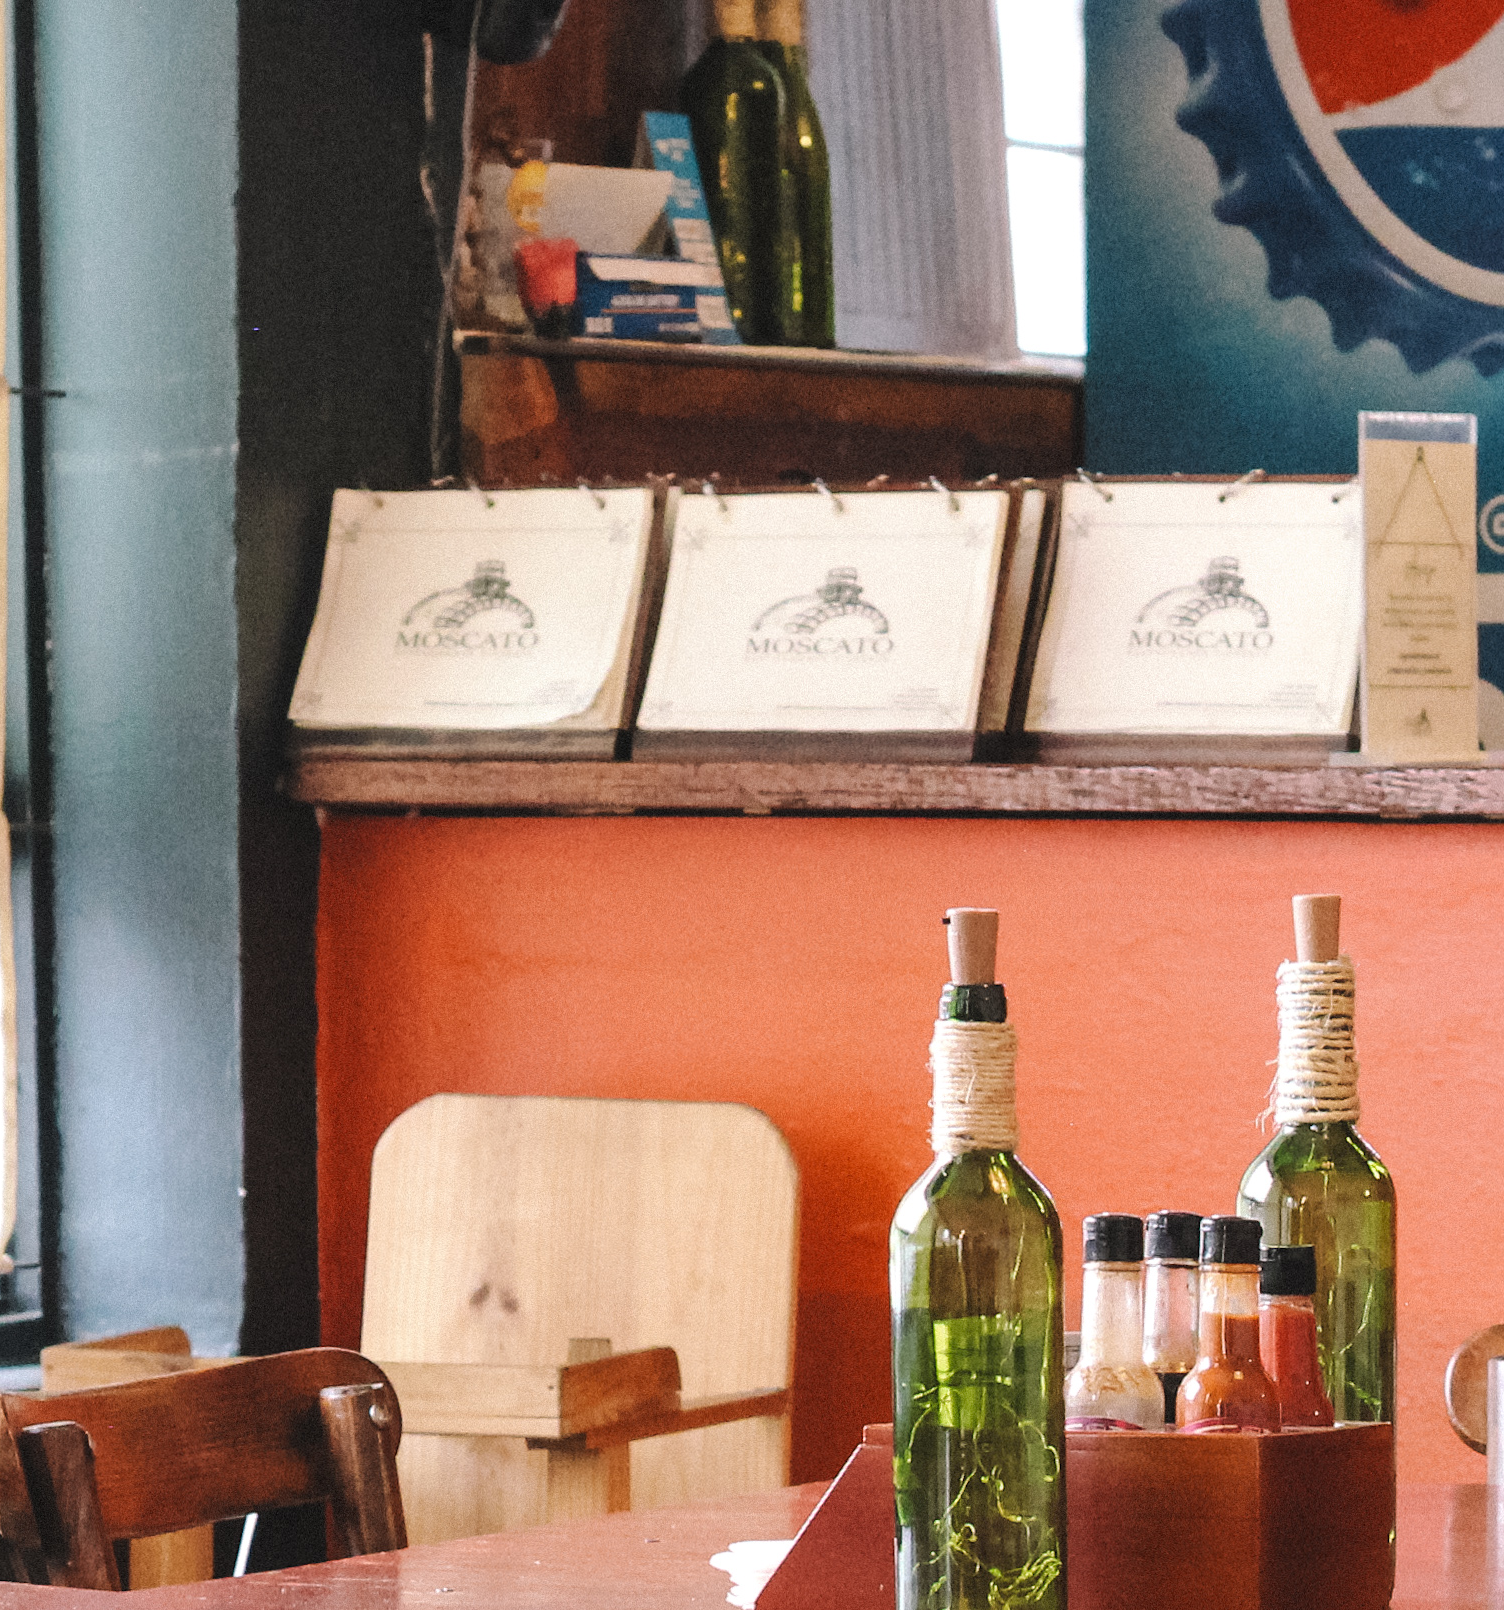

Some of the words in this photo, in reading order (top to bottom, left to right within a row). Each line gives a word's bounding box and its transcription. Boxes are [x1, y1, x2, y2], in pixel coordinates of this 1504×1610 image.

[396, 631, 539, 649] MOSCATO
[746, 636, 894, 655] MOSCATO
[1128, 629, 1274, 650] MOSCATO
